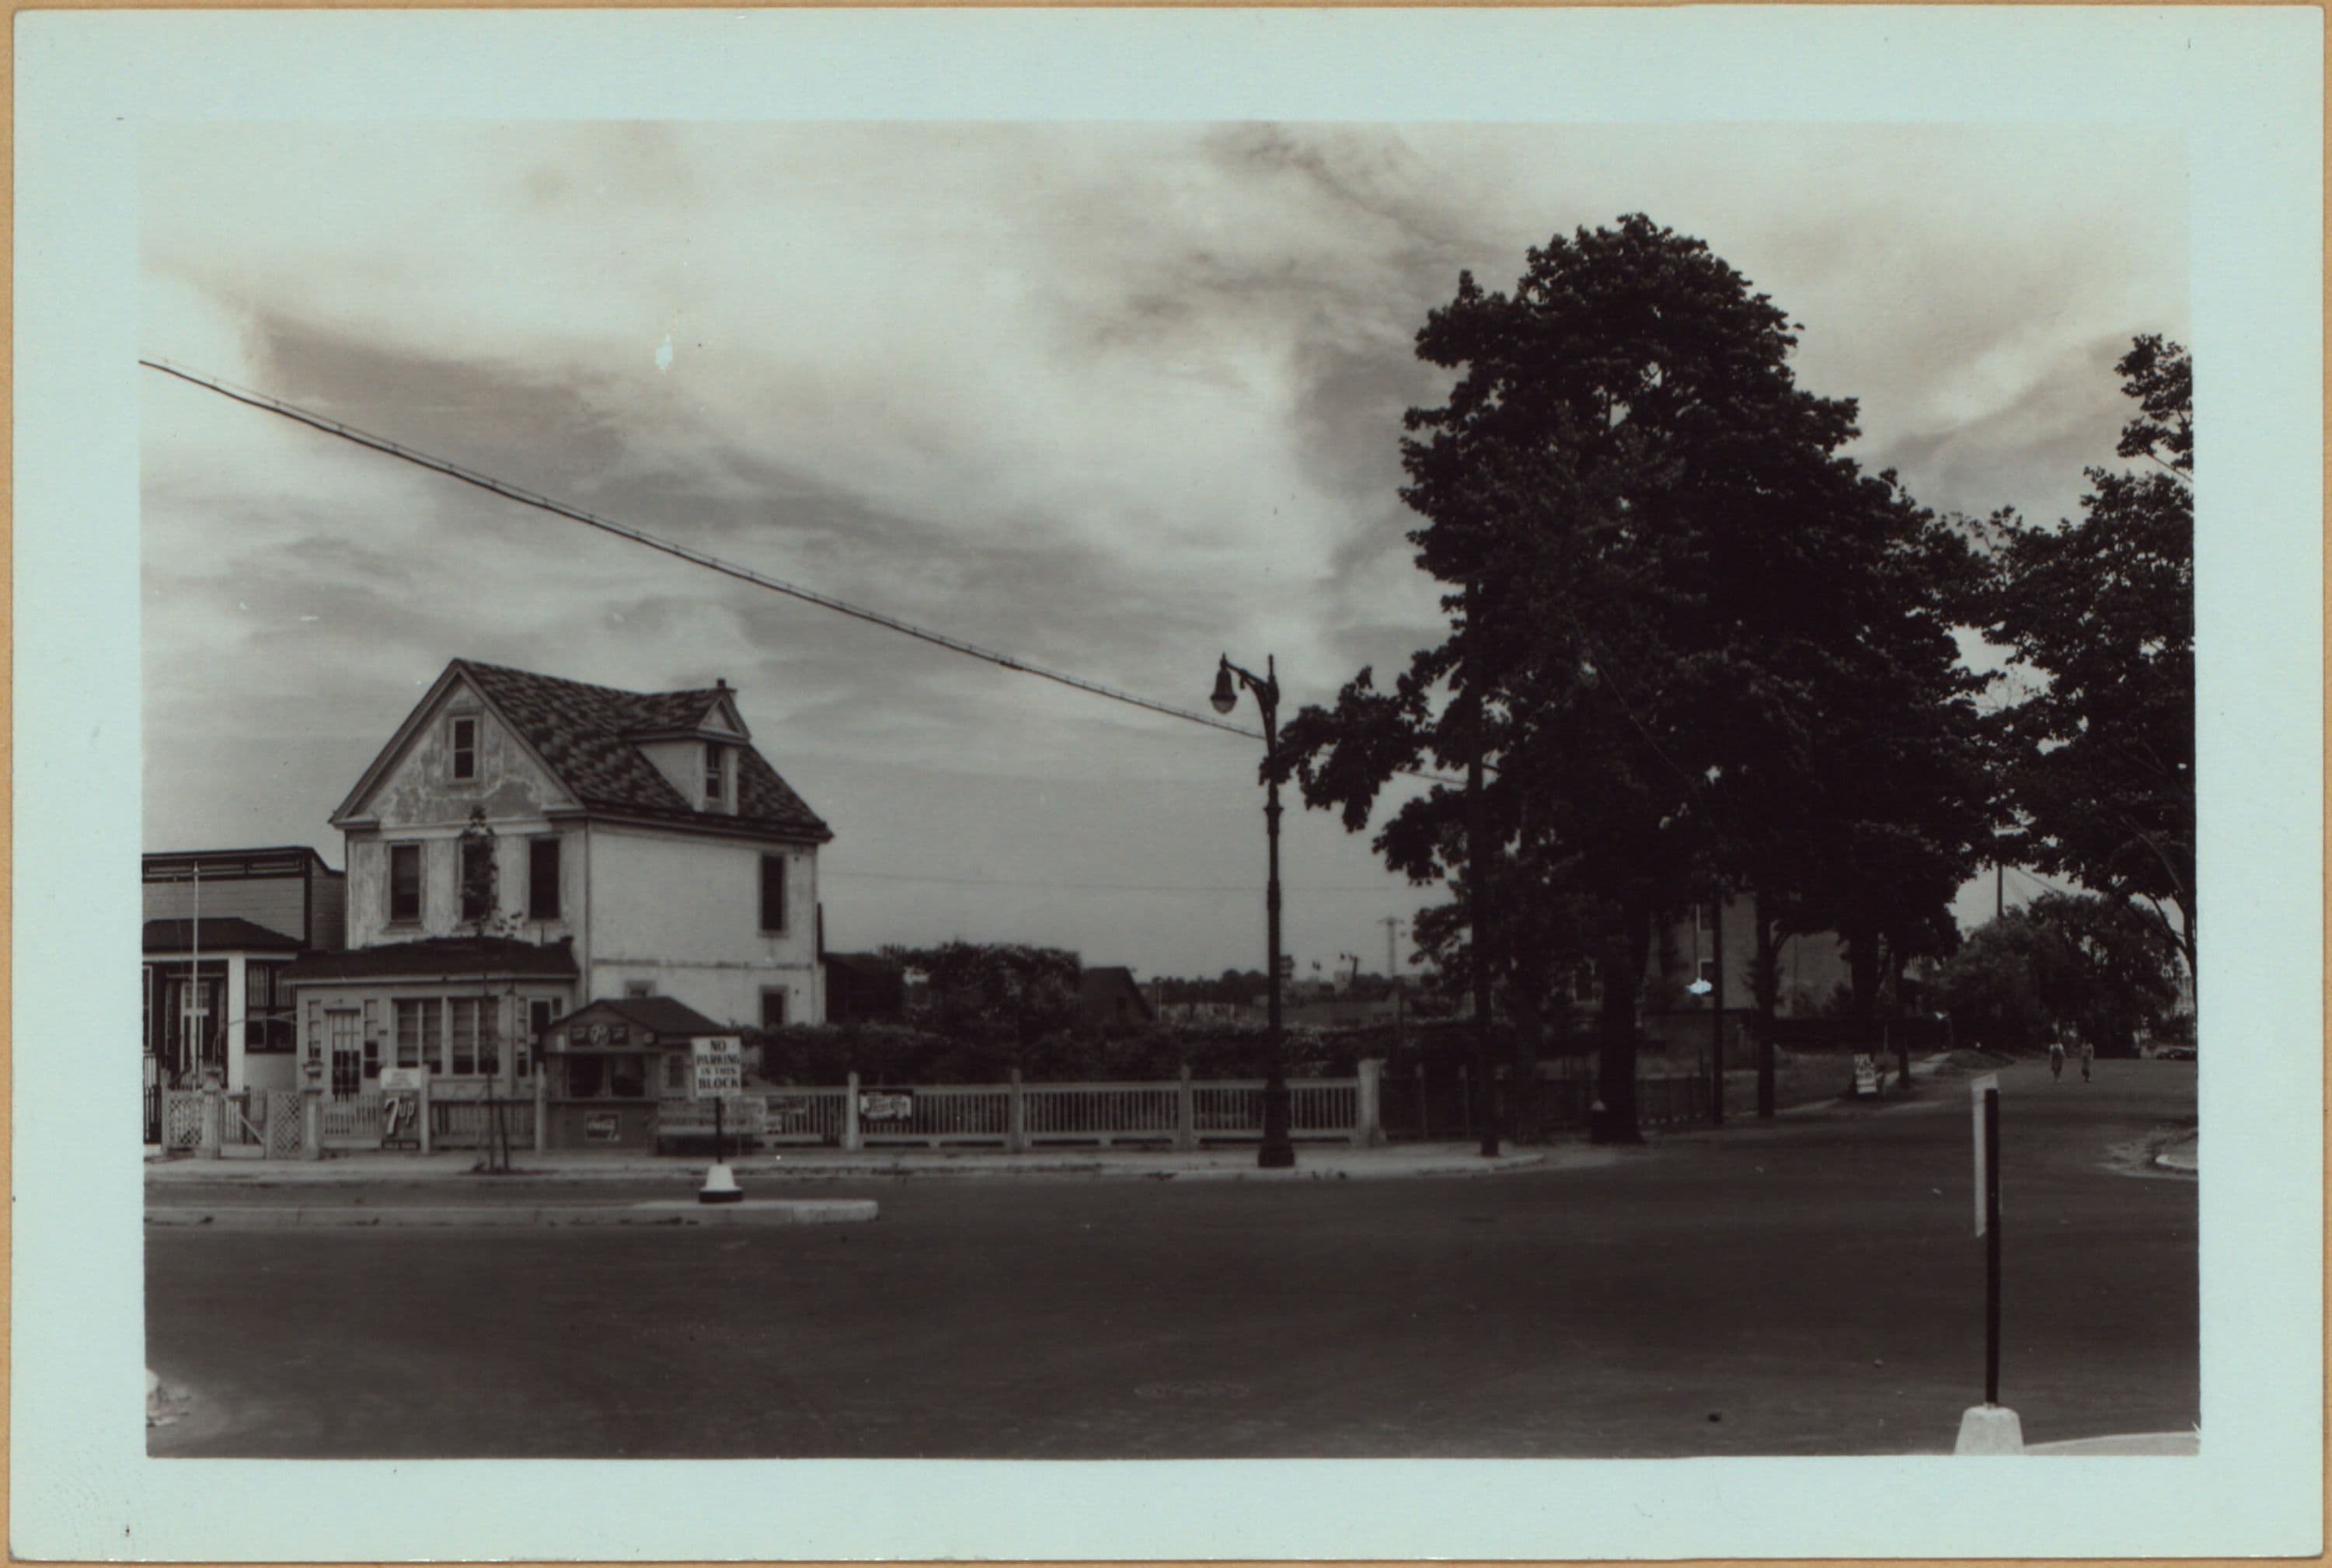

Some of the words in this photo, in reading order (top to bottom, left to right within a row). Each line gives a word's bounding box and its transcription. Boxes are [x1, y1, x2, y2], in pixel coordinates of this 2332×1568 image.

[710, 1040, 727, 1052] NO
[696, 1054, 740, 1065] PARKING
[699, 1078, 739, 1089] BLOCK
